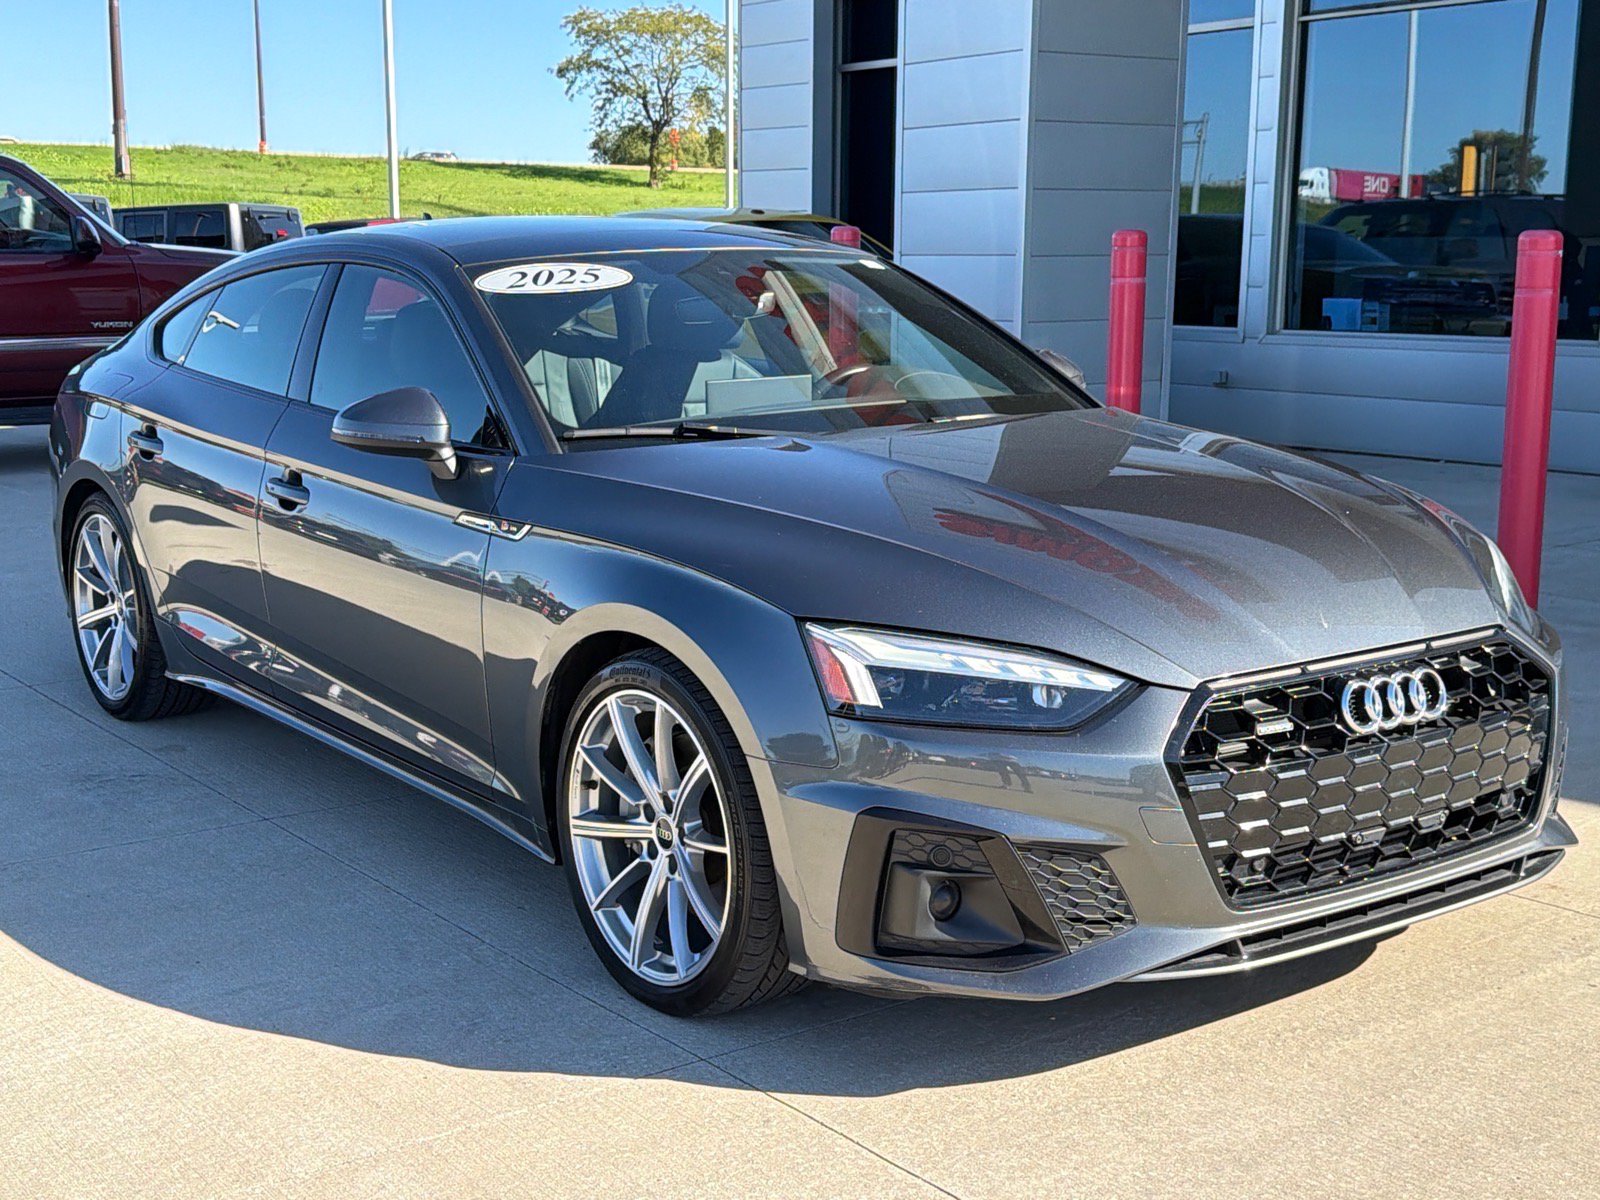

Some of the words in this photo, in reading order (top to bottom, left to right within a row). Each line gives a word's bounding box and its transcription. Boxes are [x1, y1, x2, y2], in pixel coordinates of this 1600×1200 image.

[506, 268, 601, 289] 2025
[90, 321, 134, 329] YUKON
[609, 665, 647, 679] Continental
